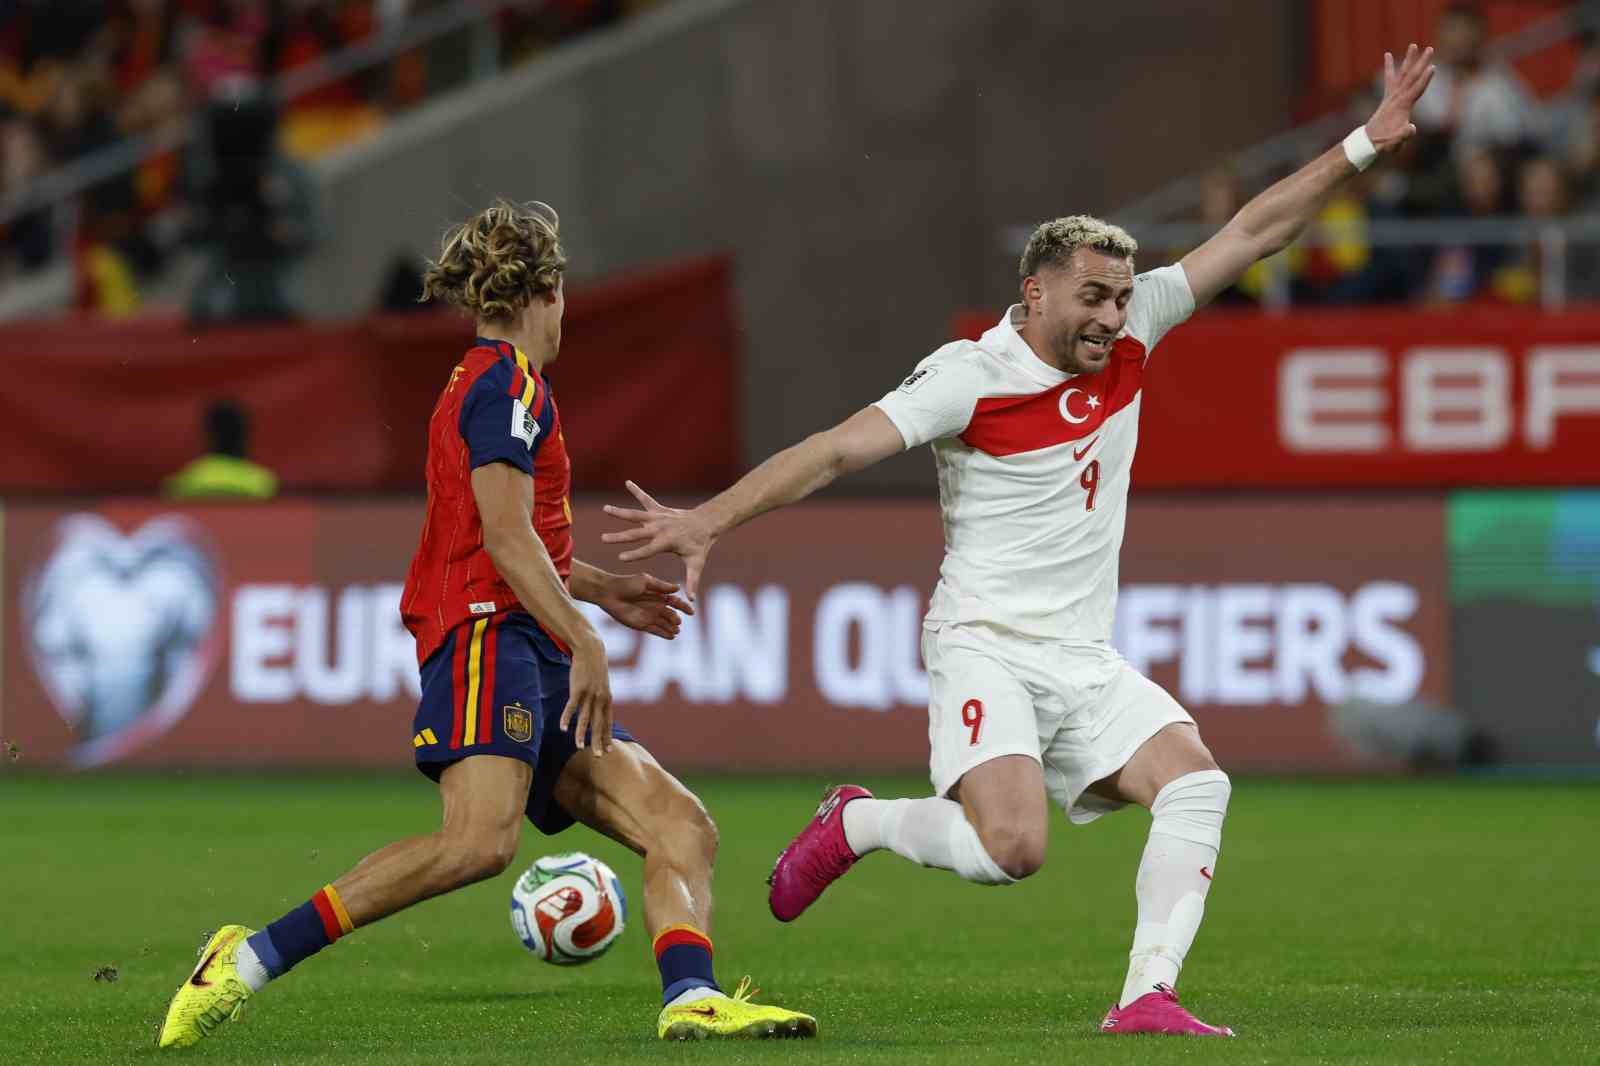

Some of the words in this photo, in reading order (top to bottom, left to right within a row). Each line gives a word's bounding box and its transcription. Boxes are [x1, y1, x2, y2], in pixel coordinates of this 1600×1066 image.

[1080, 459, 1100, 512] 9
[231, 582, 789, 703] EURAN
[813, 581, 1424, 709] QUFIERS
[962, 698, 984, 746] 9
